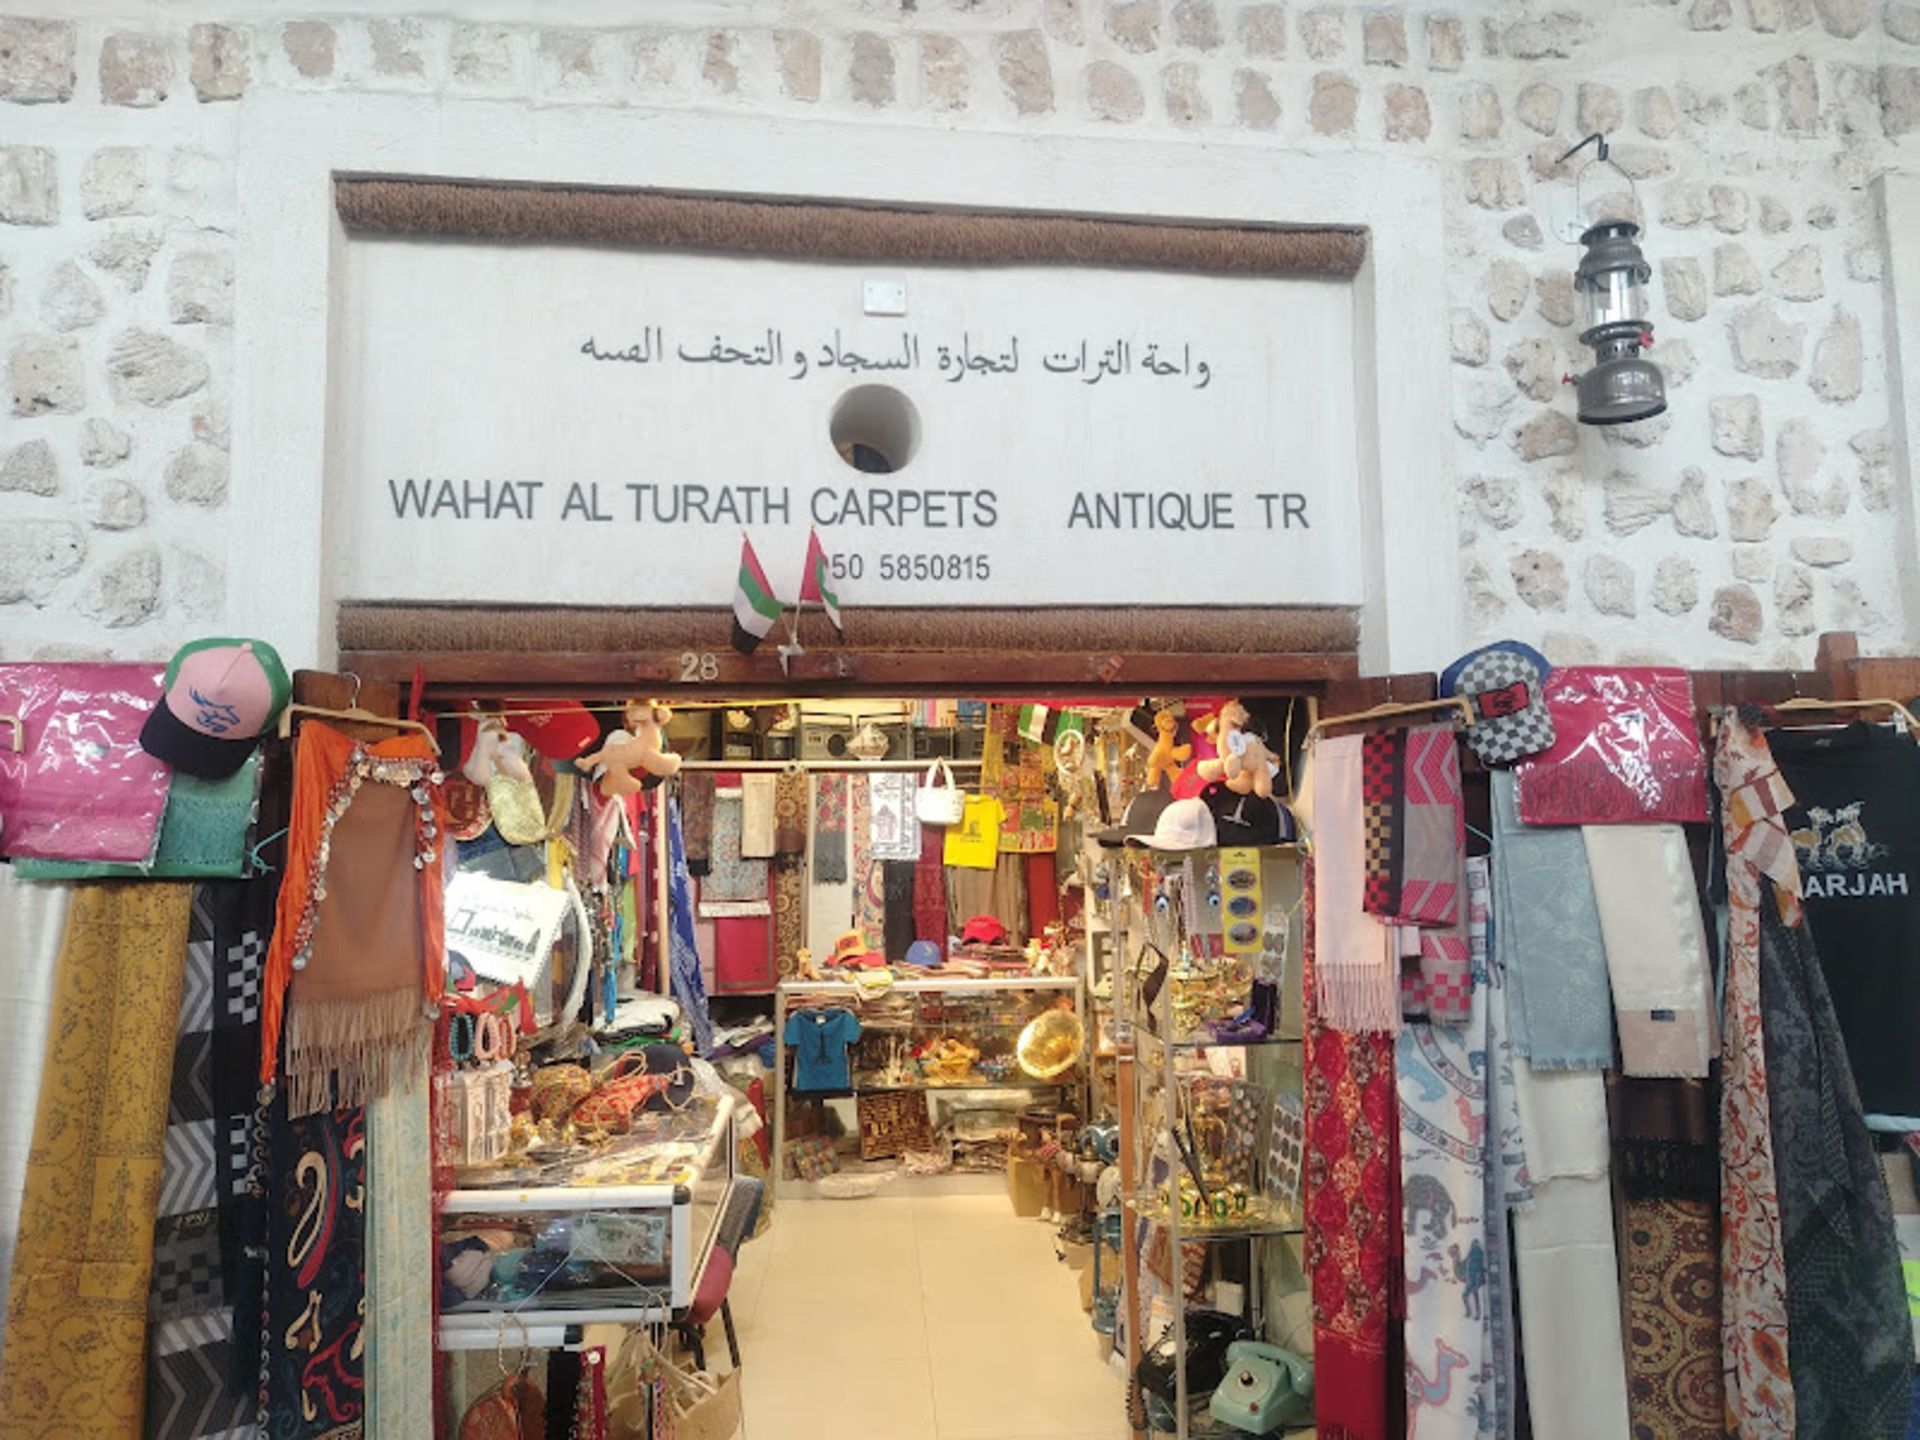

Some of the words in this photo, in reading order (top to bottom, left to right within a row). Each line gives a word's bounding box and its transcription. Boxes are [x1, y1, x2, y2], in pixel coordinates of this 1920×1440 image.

[817, 329, 920, 374] السجاد
[936, 331, 1019, 383] لتجارة
[1141, 342, 1211, 390] واحة
[388, 478, 543, 520] WAHAT
[561, 481, 613, 522] AL
[626, 483, 790, 525] TURATH
[811, 486, 998, 529] CARPETS
[1068, 491, 1235, 532] ANTIQUE
[1256, 493, 1310, 530] TR
[824, 553, 864, 582] 50
[879, 553, 991, 582] 5850815
[680, 651, 719, 682] 28
[1804, 872, 1909, 898] ARJAH
